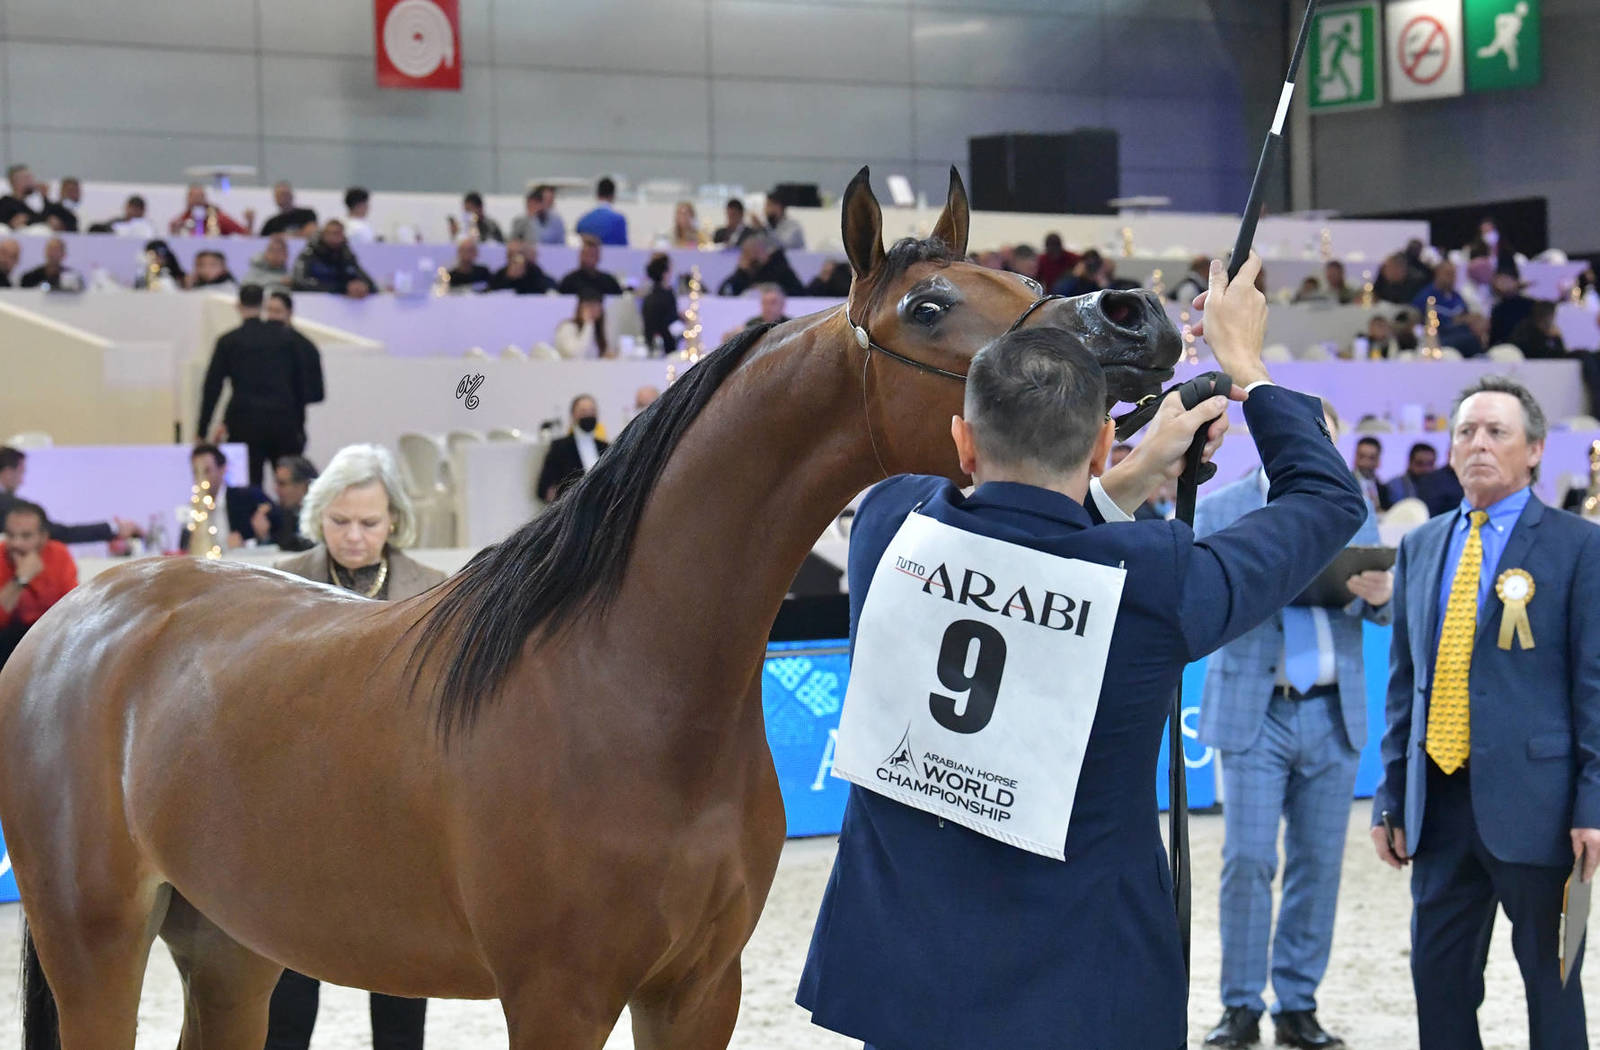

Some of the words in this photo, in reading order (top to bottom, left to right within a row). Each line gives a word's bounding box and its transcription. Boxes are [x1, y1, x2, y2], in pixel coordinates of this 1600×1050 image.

[896, 556, 925, 576] TUTTO
[922, 562, 1092, 637] ARABI
[929, 619, 1007, 735] 9
[876, 767, 1011, 822] CHAMPIONSHIP
[923, 752, 974, 775] ARABIAN
[977, 769, 1018, 789] HORSE
[923, 762, 1015, 808] WORLD
